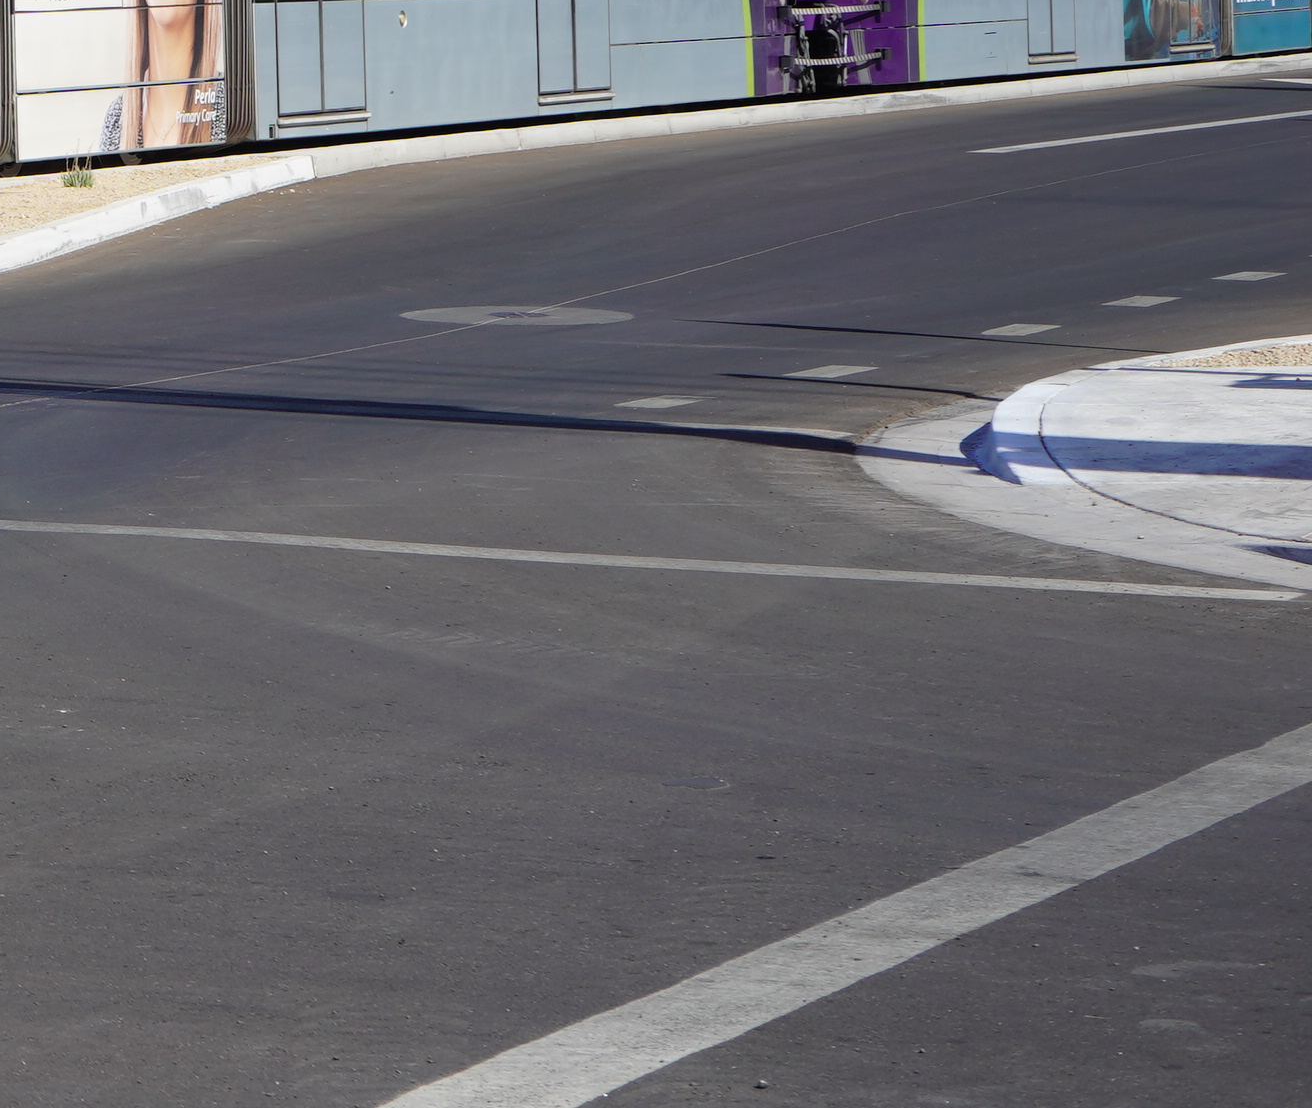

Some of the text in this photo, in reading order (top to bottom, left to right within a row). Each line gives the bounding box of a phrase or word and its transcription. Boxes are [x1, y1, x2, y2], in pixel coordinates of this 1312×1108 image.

[194, 88, 216, 104] Perla
[176, 109, 217, 126] Primary Care
